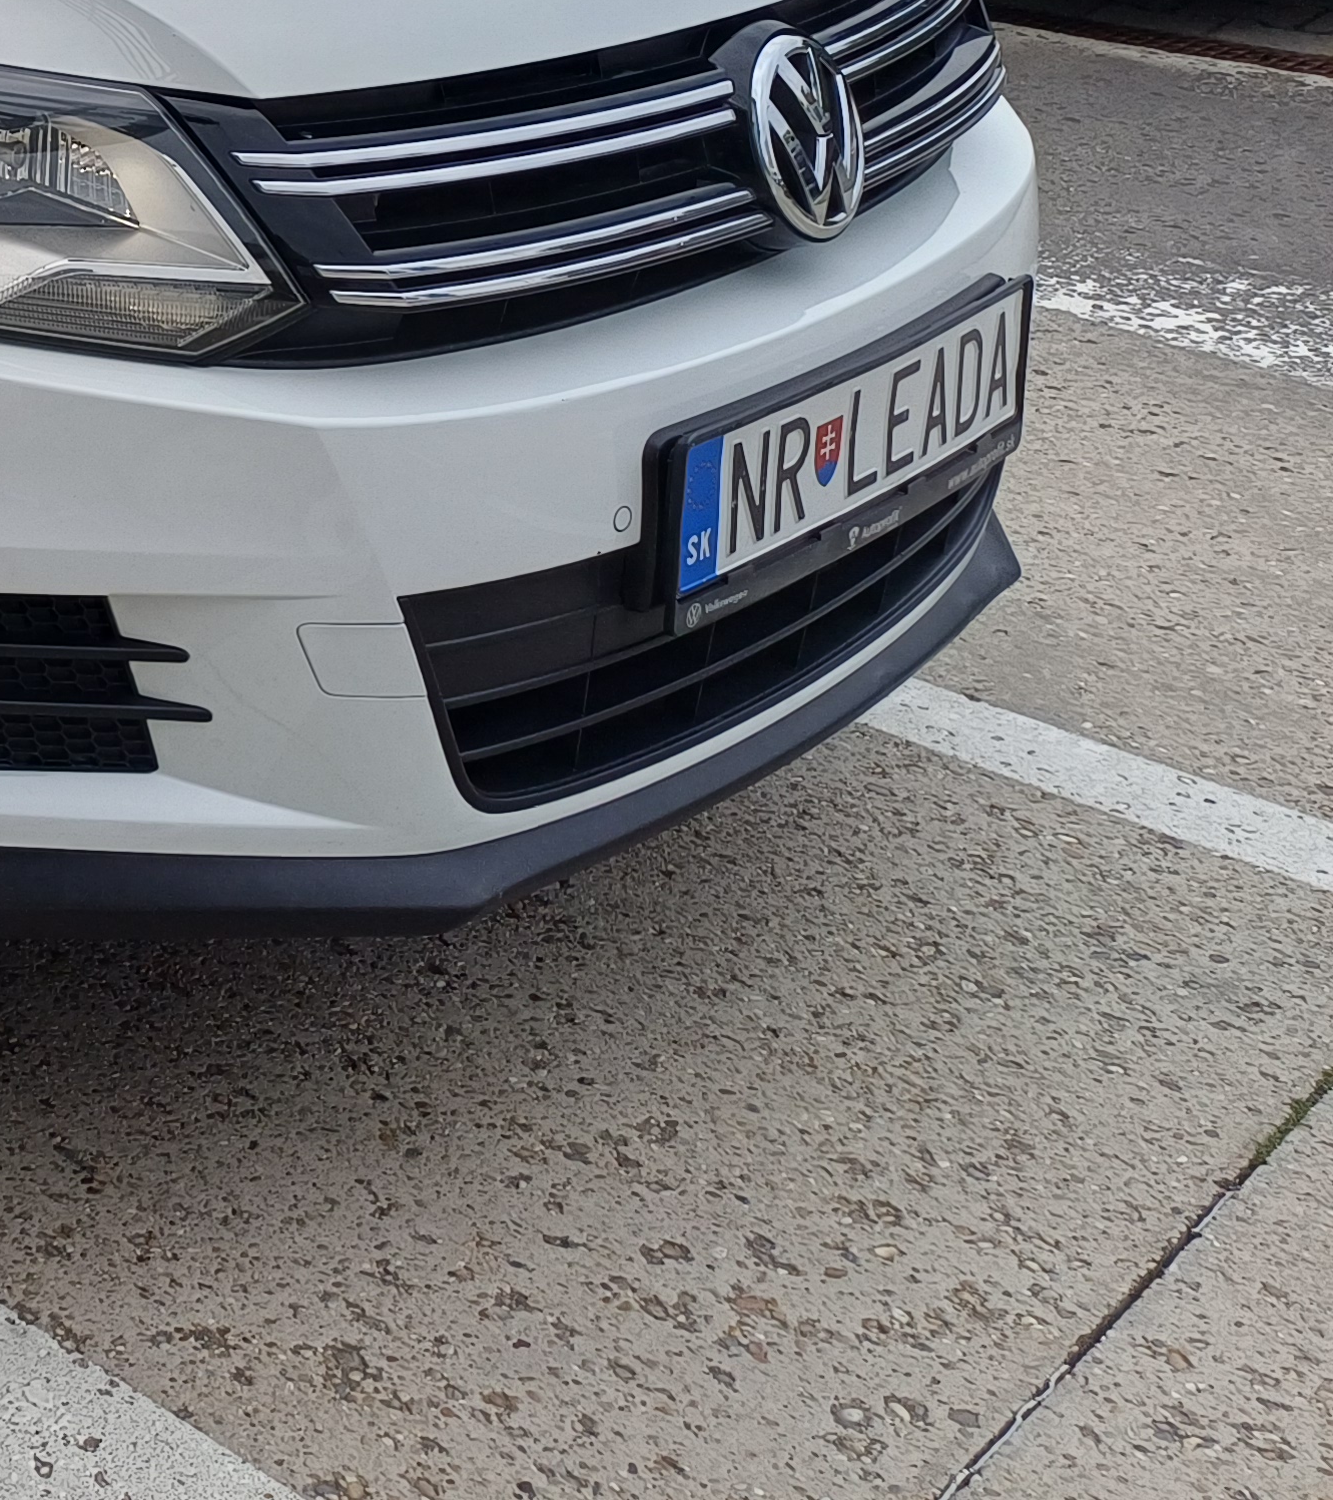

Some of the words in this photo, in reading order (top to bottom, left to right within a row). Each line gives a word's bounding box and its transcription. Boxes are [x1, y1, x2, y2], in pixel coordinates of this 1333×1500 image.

[729, 417, 811, 554] NR
[847, 311, 1007, 497] LEADA
[687, 528, 711, 566] SK
